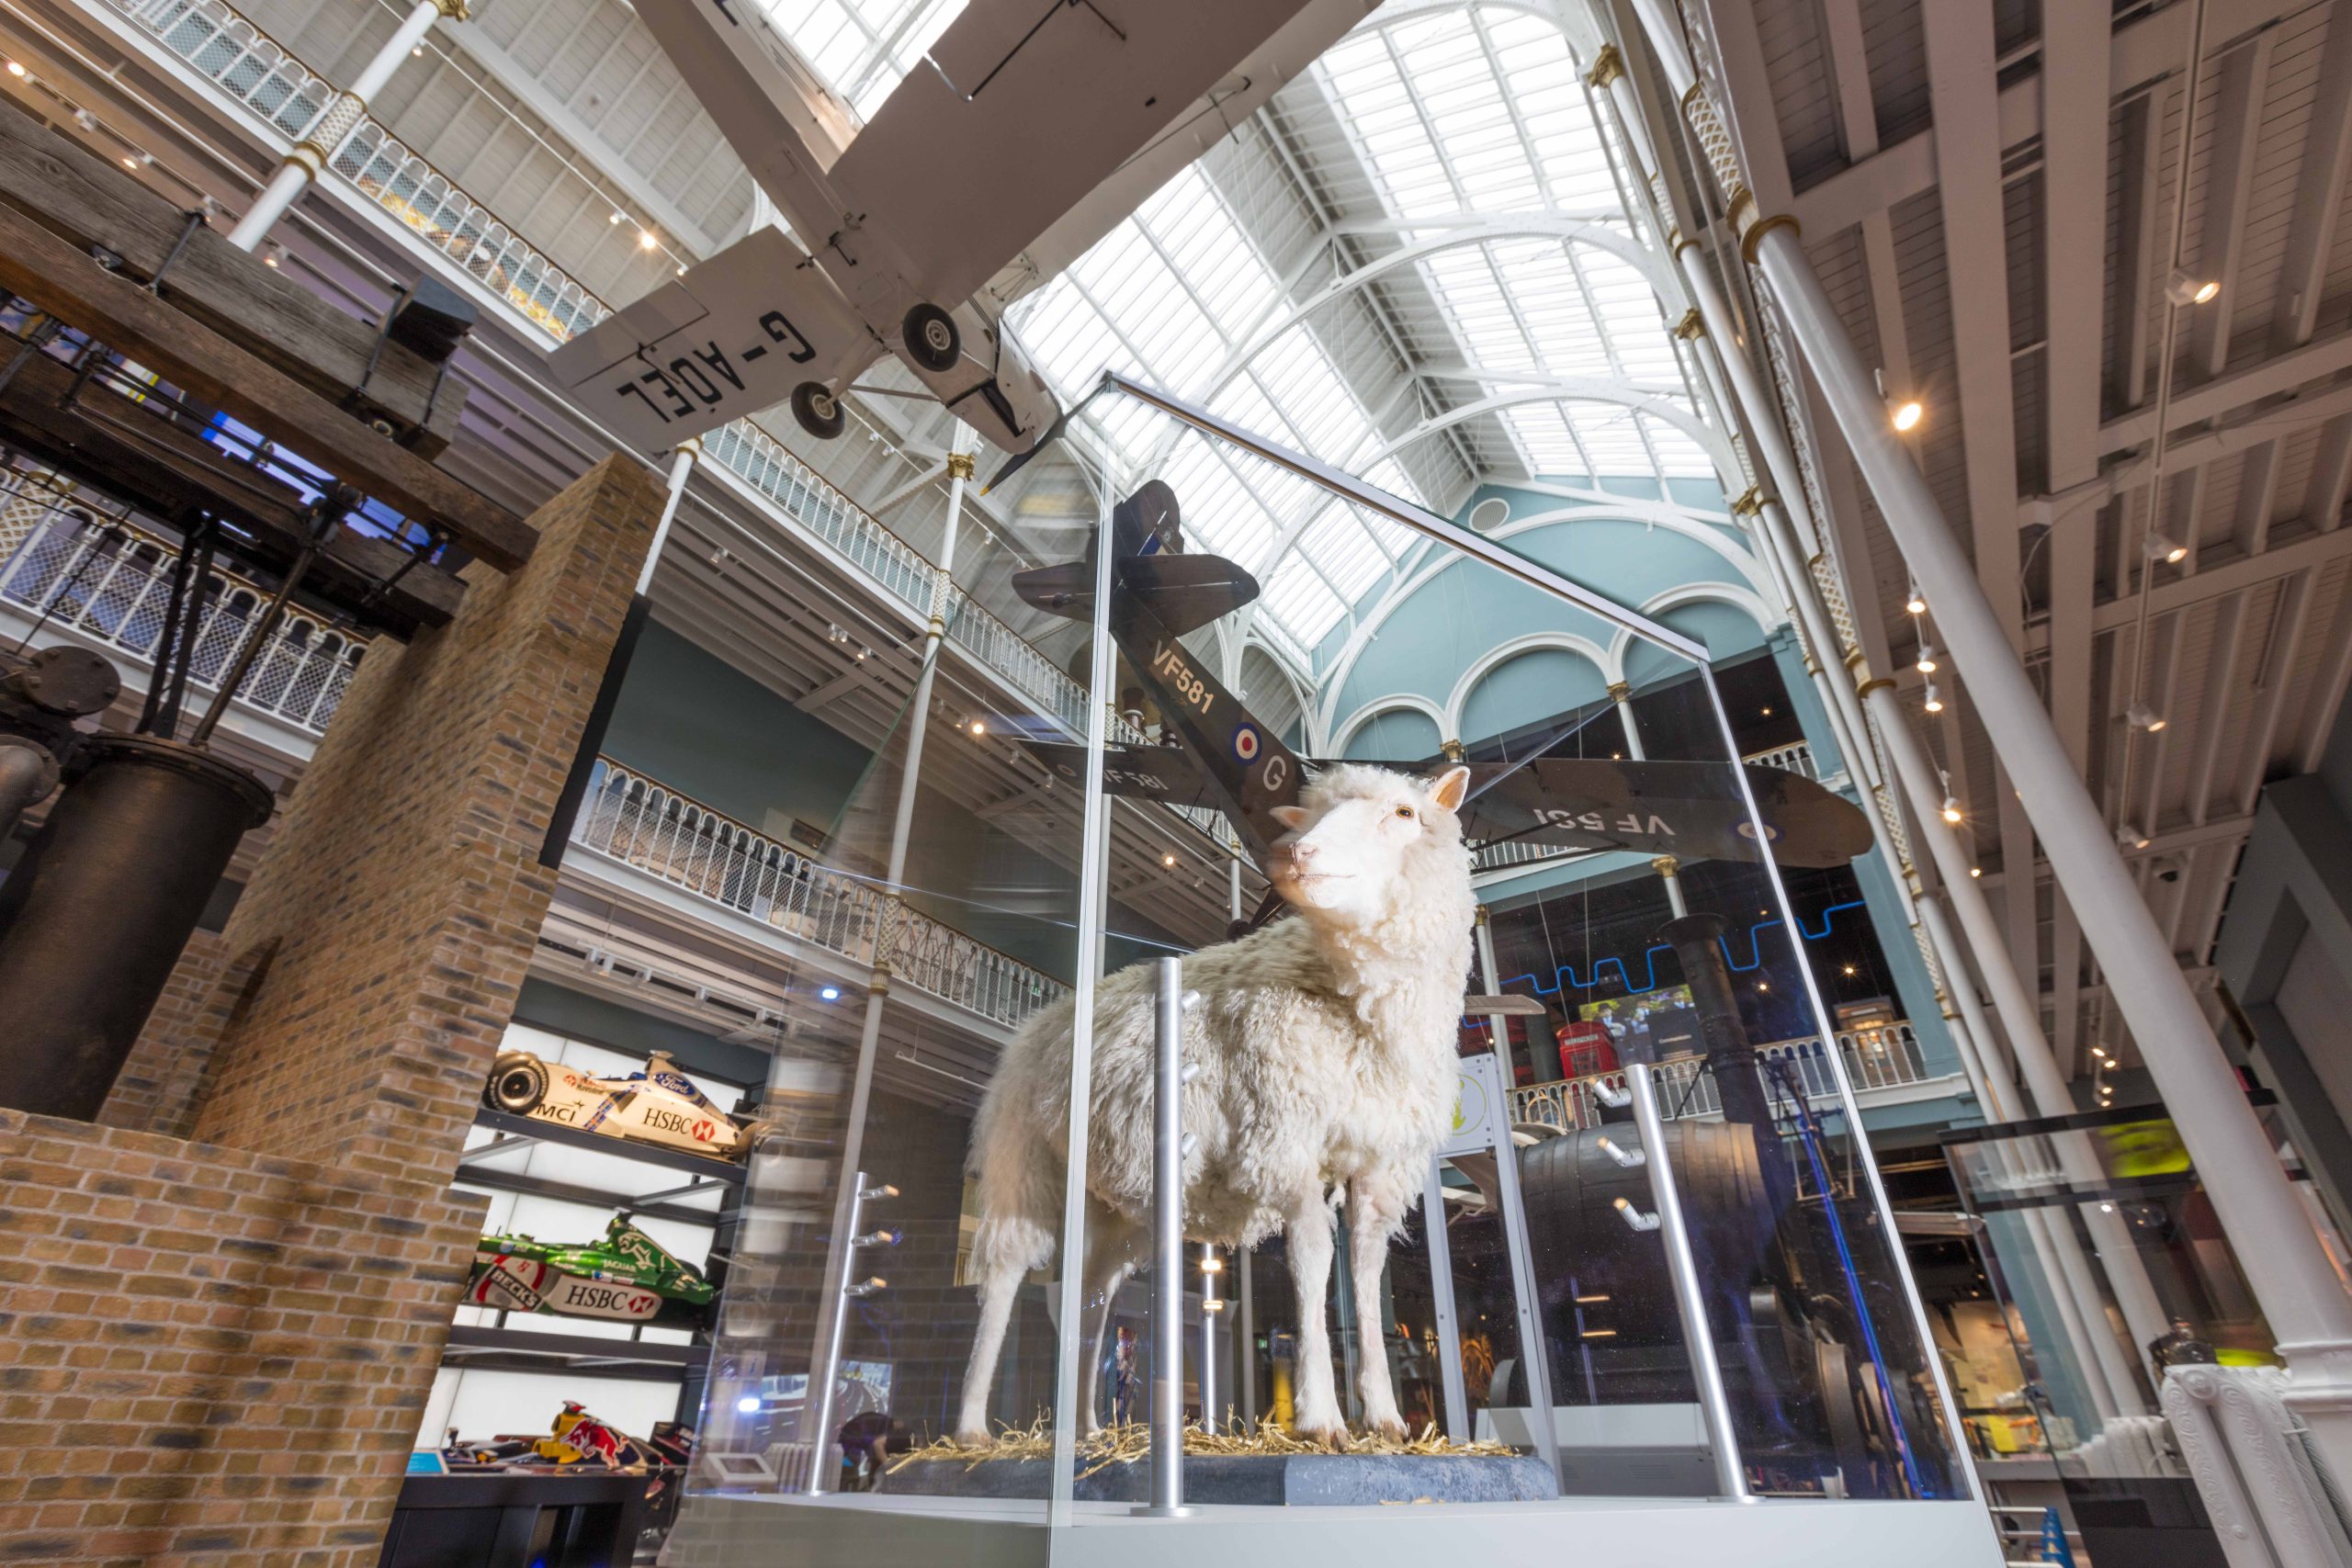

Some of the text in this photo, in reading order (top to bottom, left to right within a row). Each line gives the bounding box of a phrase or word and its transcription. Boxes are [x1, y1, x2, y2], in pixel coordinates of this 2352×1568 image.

[616, 310, 816, 423] G-AOEL
[1153, 638, 1215, 715] VF581
[1262, 755, 1286, 791] G
[1616, 814, 1676, 836] VF
[662, 1074, 689, 1094] Ford
[537, 1103, 577, 1122] MCI
[642, 1107, 693, 1134] HSBC
[565, 1284, 629, 1311] HSBC
